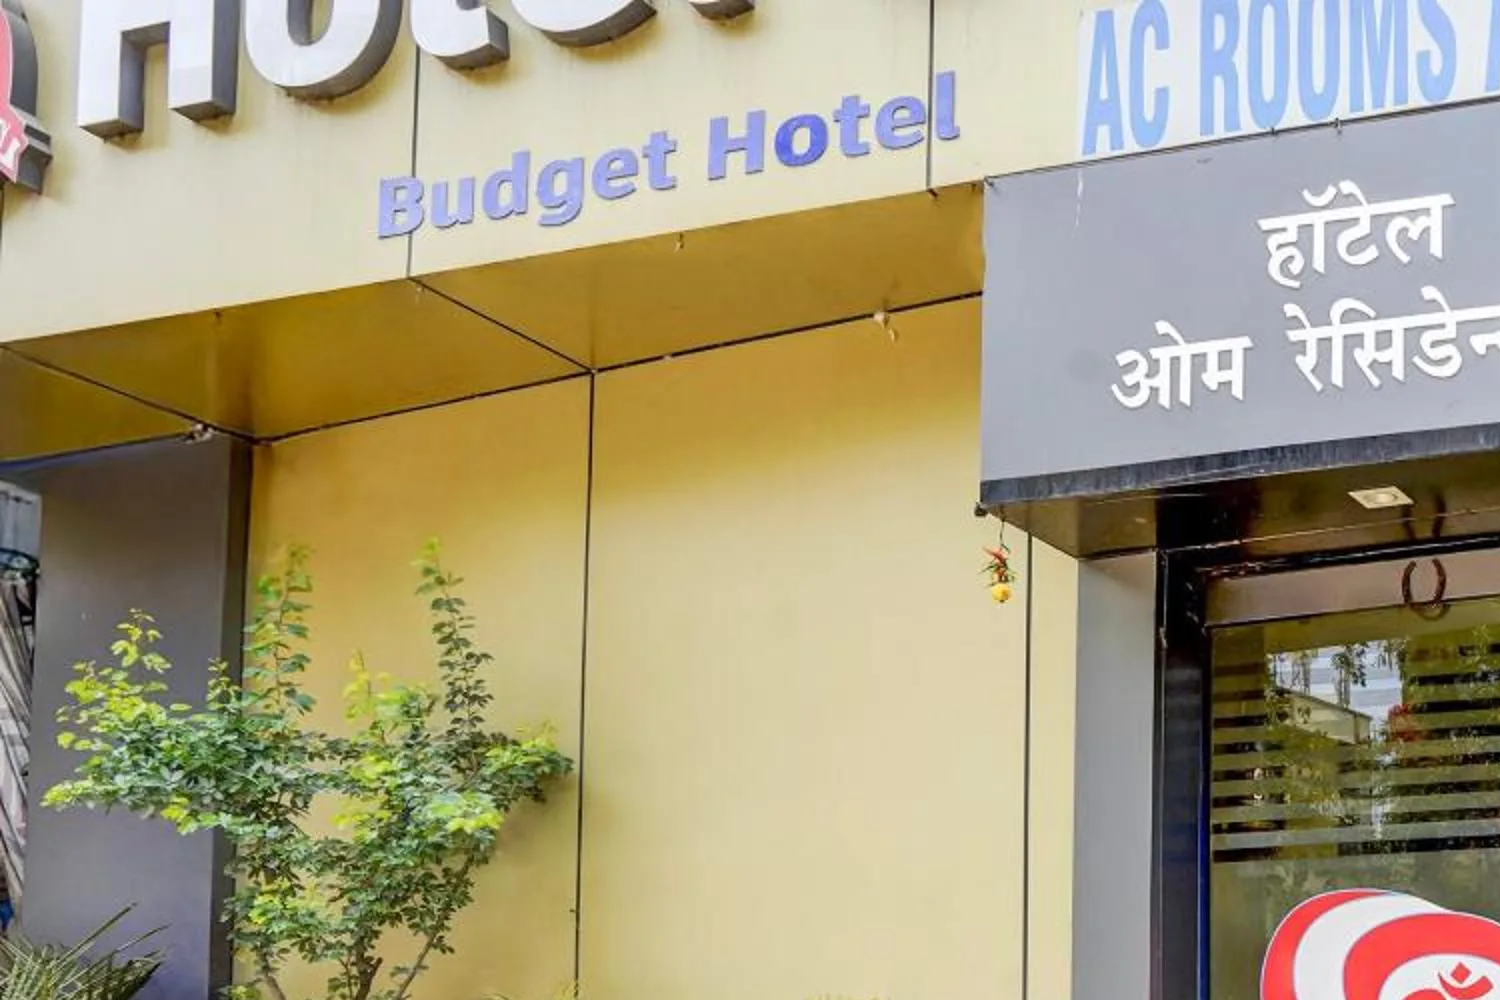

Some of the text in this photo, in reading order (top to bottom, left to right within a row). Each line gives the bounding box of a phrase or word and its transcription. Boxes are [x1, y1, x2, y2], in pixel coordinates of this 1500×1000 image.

[1082, 0, 1170, 156] AC
[1200, 0, 1457, 136] ROOMS
[378, 70, 961, 239] Budget Hotel
[1258, 180, 1456, 288] हॉटेल
[1112, 320, 1253, 409] ओम
